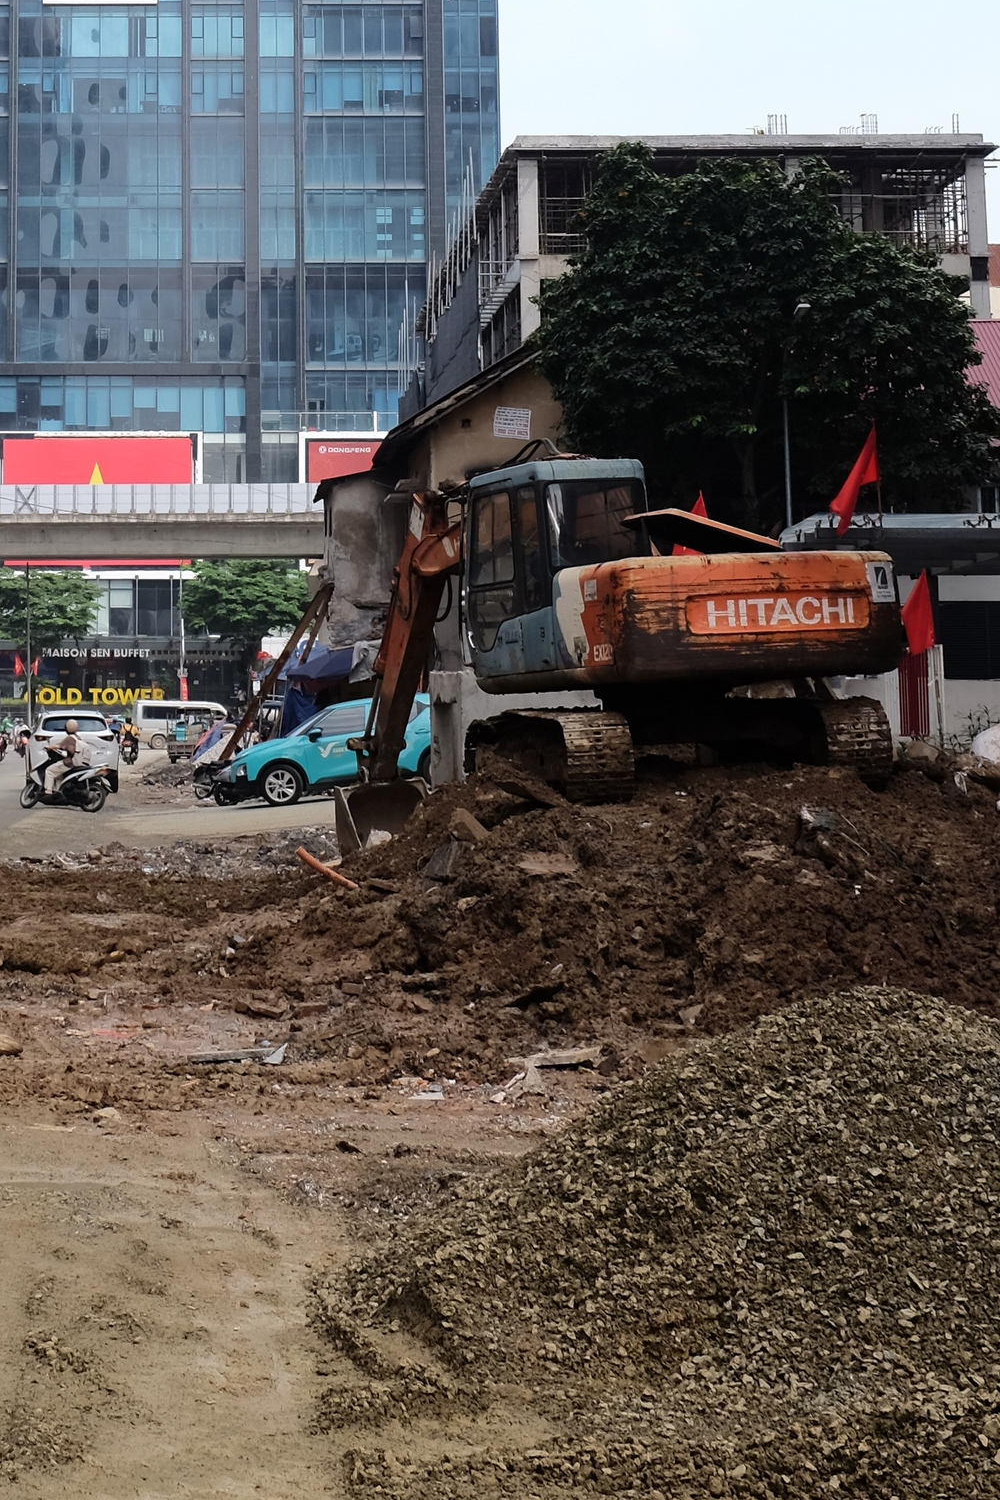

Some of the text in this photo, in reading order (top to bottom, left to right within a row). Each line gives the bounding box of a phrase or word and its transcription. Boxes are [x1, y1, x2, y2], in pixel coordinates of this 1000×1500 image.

[706, 596, 855, 628] HITACHI
[41, 648, 150, 658] MAISON SEN BUFFET
[89, 687, 165, 705] TOWER
